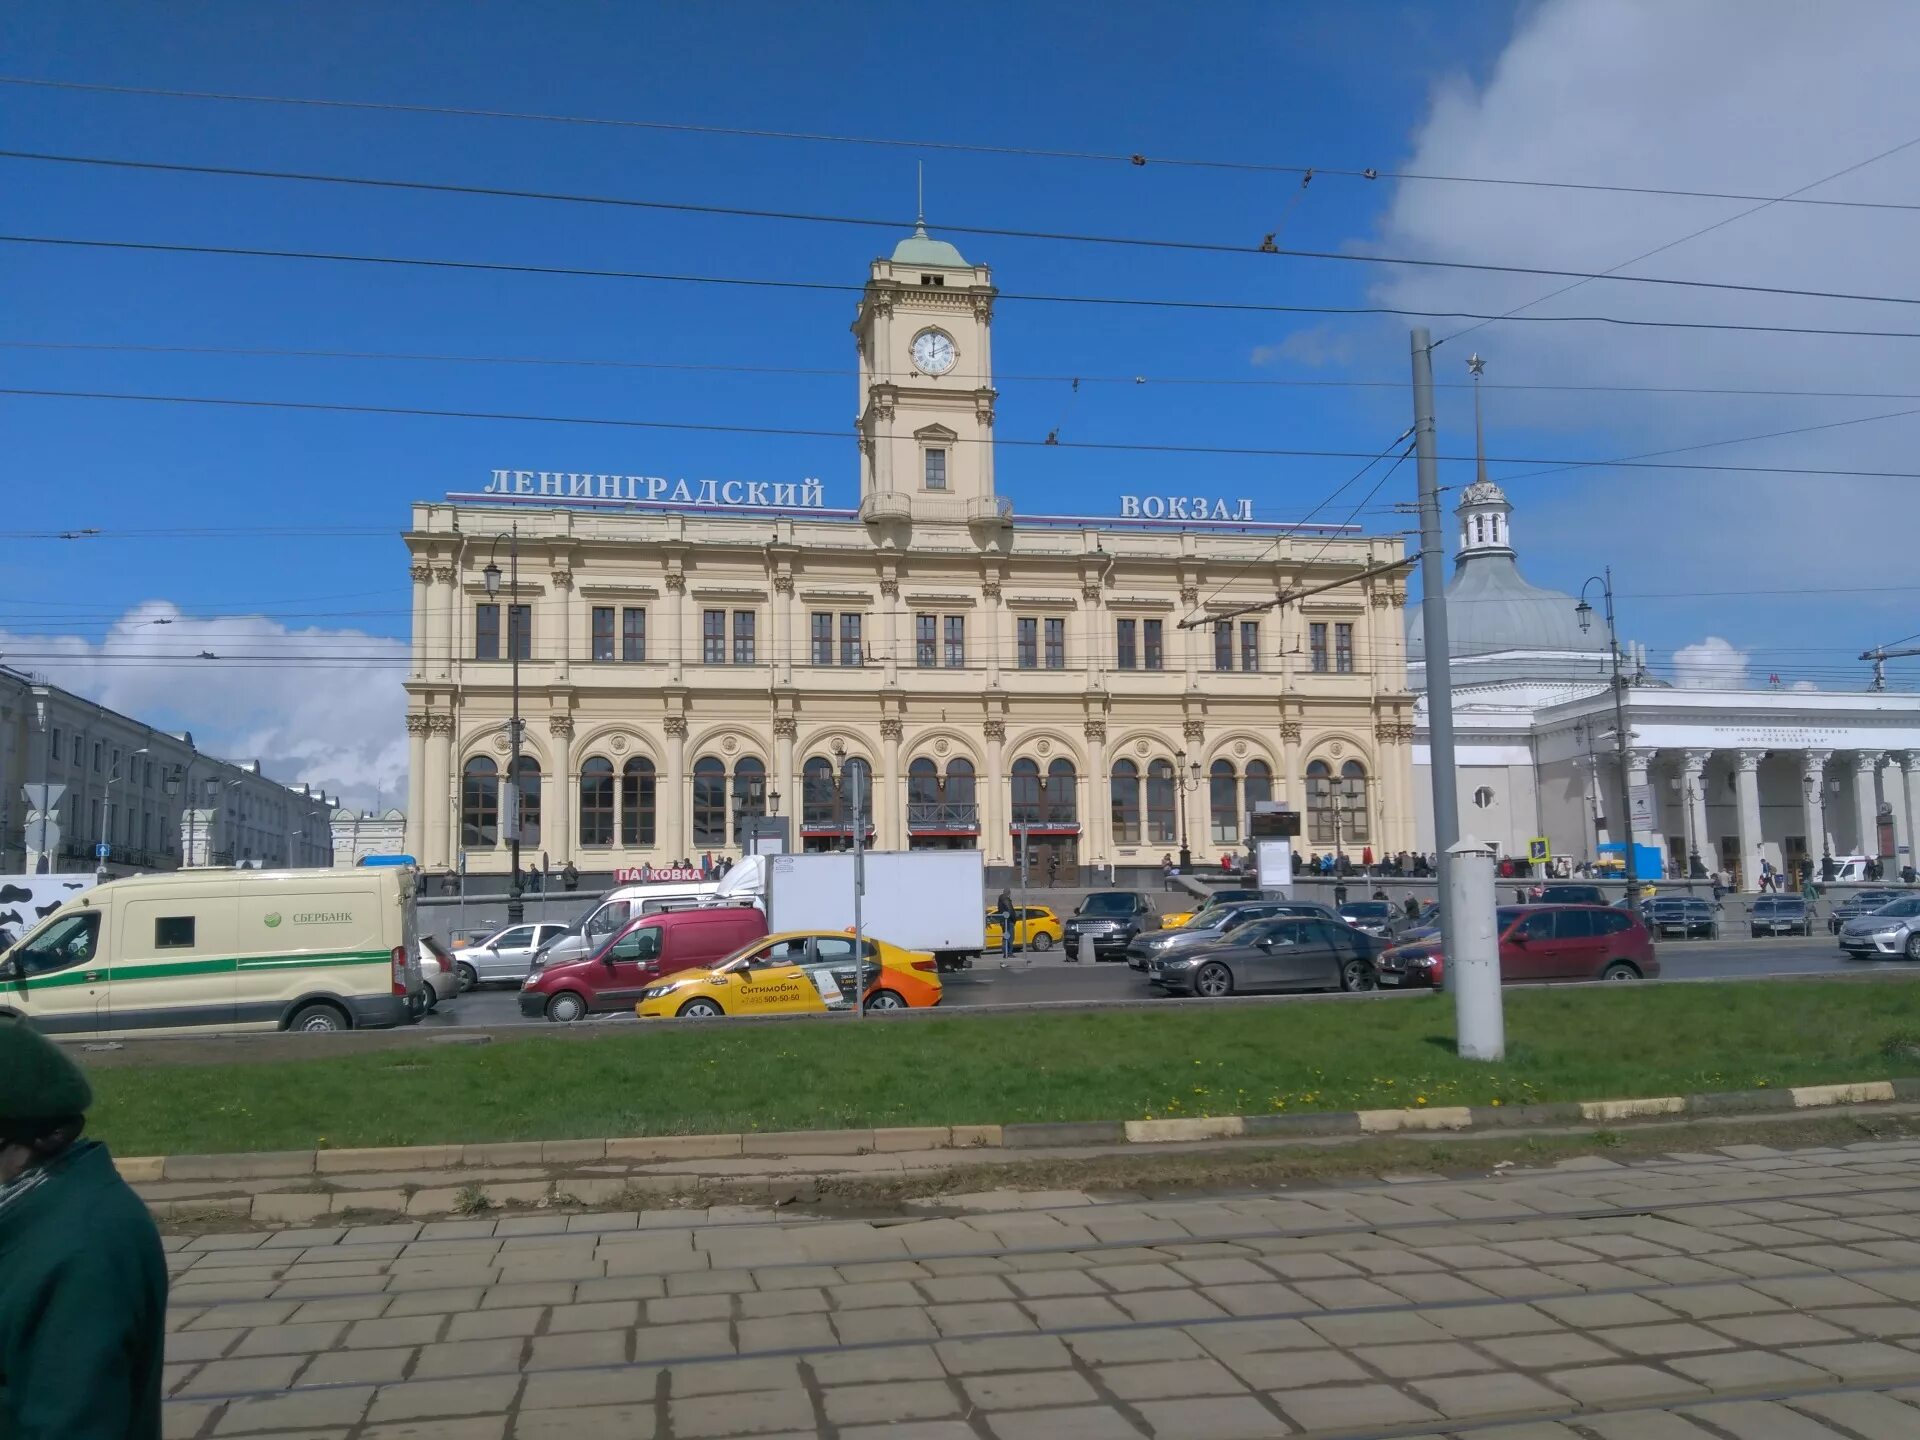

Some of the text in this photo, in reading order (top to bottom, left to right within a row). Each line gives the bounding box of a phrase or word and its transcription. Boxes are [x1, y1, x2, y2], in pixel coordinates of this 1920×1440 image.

[484, 469, 1254, 520] ЛЕНИНГРАДСКИЙ ВОКЗАЛ
[293, 912, 352, 922] СБЕРБАНК
[740, 983, 799, 994] Ситимобил
[764, 994, 800, 1003] 500-50-50
